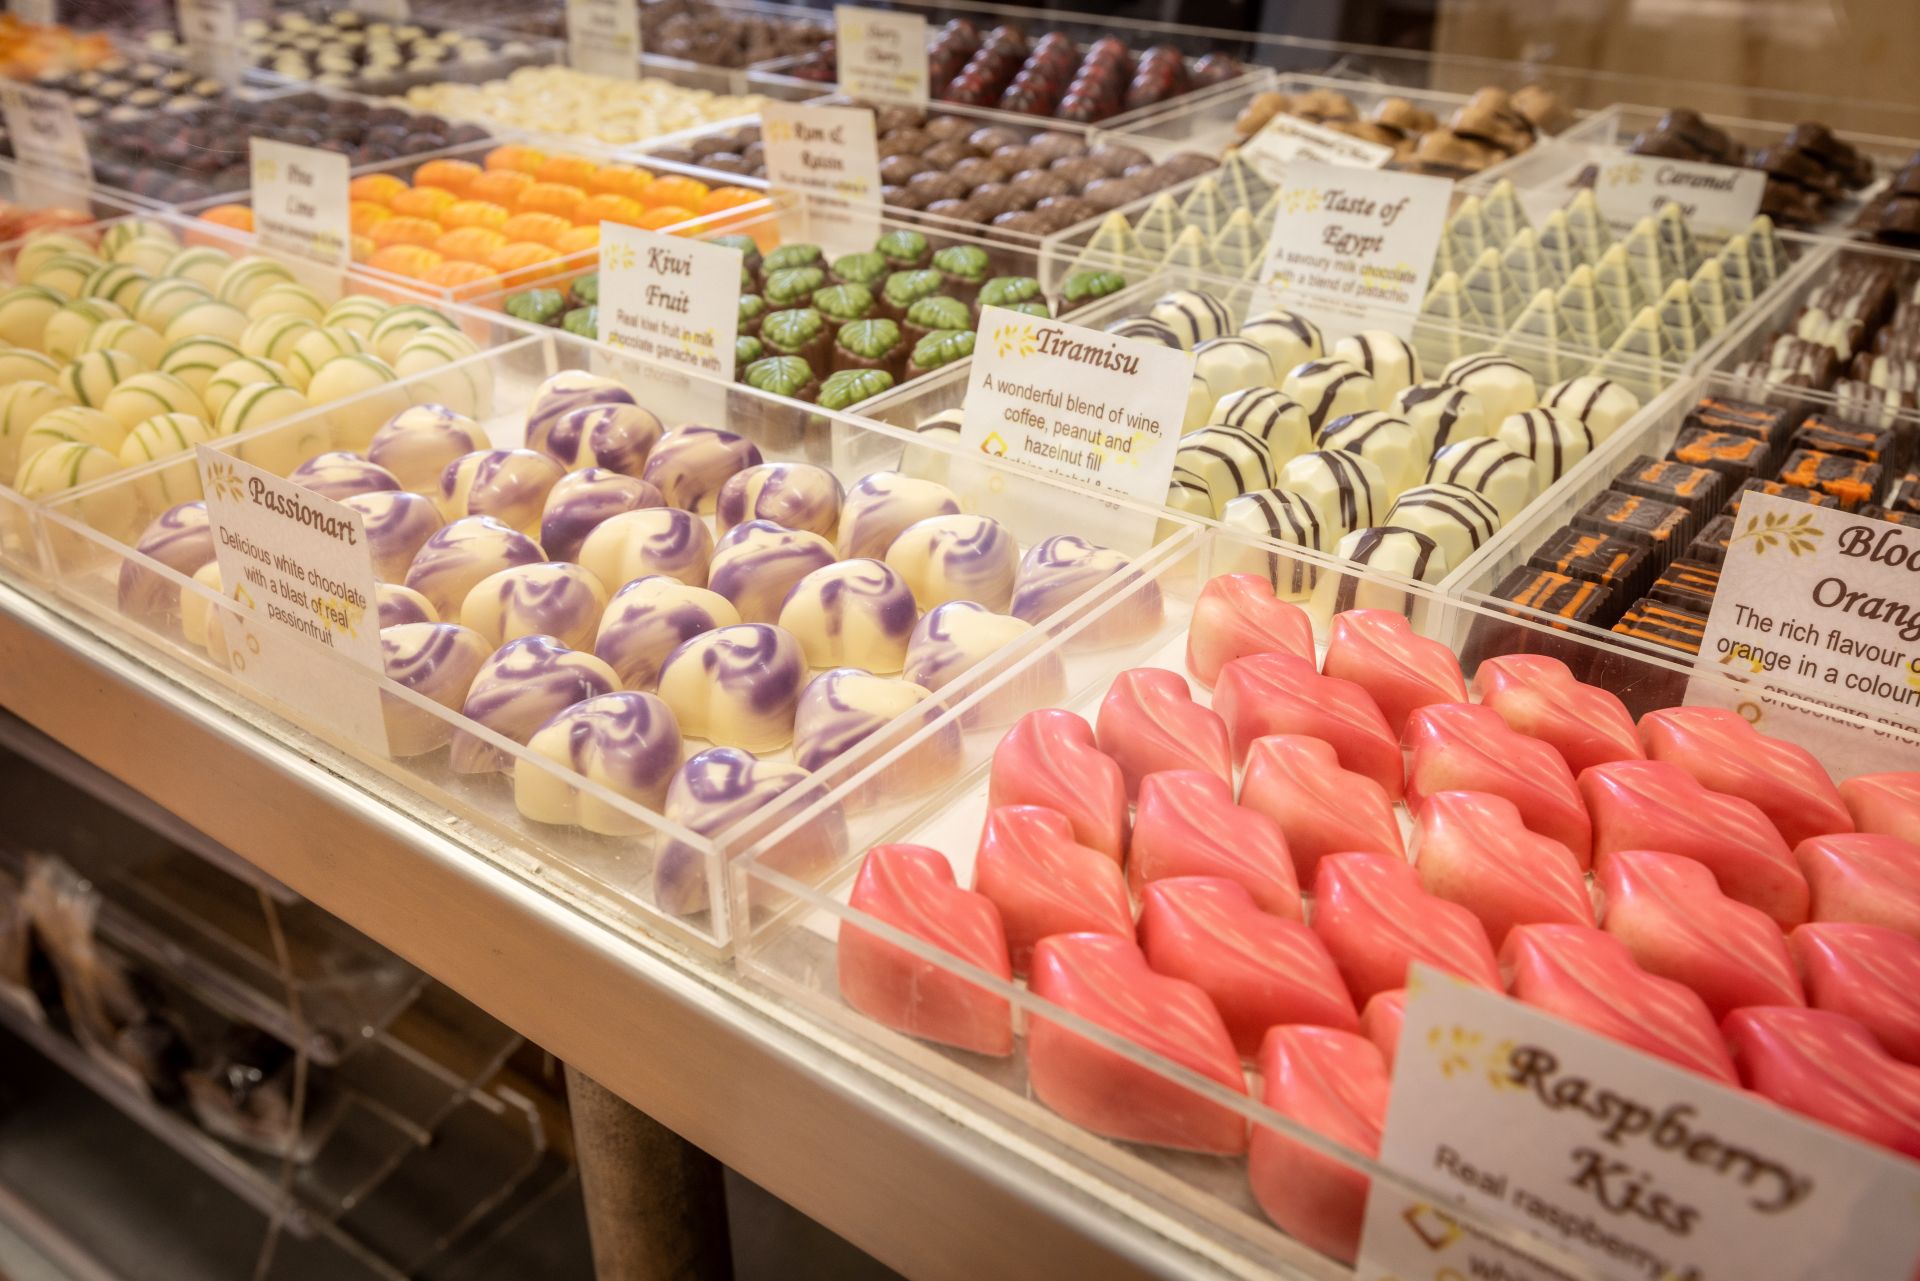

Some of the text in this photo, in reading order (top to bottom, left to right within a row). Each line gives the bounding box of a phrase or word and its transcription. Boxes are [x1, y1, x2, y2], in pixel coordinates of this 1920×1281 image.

[794, 121, 825, 143] Rum
[800, 150, 844, 171] Raisin
[1655, 164, 1741, 192] Caramel
[1324, 189, 1410, 227] Taste of
[648, 247, 693, 276] Kiwi
[1322, 225, 1384, 258] Egypt
[1308, 273, 1340, 290] blend
[1334, 258, 1356, 274] milk
[1360, 264, 1417, 284] chocolate
[646, 284, 690, 314] Fruit
[609, 331, 653, 352] chocolate
[617, 308, 638, 327] Real
[694, 330, 714, 347] milk
[1036, 327, 1139, 375] Tiramisu
[982, 373, 1162, 438] A wonderful blend of wine,
[1004, 407, 1132, 453] coffee, peanut and
[1025, 436, 1081, 466] hazelnut
[1087, 452, 1102, 472] fill
[249, 477, 357, 545] Passionart
[220, 525, 366, 610] Delicious white chocolate
[244, 565, 349, 629] with a blast of real
[268, 602, 335, 648] passionfruit
[1735, 603, 1773, 633] The
[1779, 619, 1820, 646] rich
[1826, 630, 1905, 669] flavour
[1717, 637, 1791, 672] orange
[1798, 654, 1818, 679] in
[1824, 668, 1838, 684] a
[1509, 1045, 1815, 1215] Raspberry
[1435, 1144, 1671, 1280] Real raspberry
[1569, 1147, 1700, 1237] Kiss
